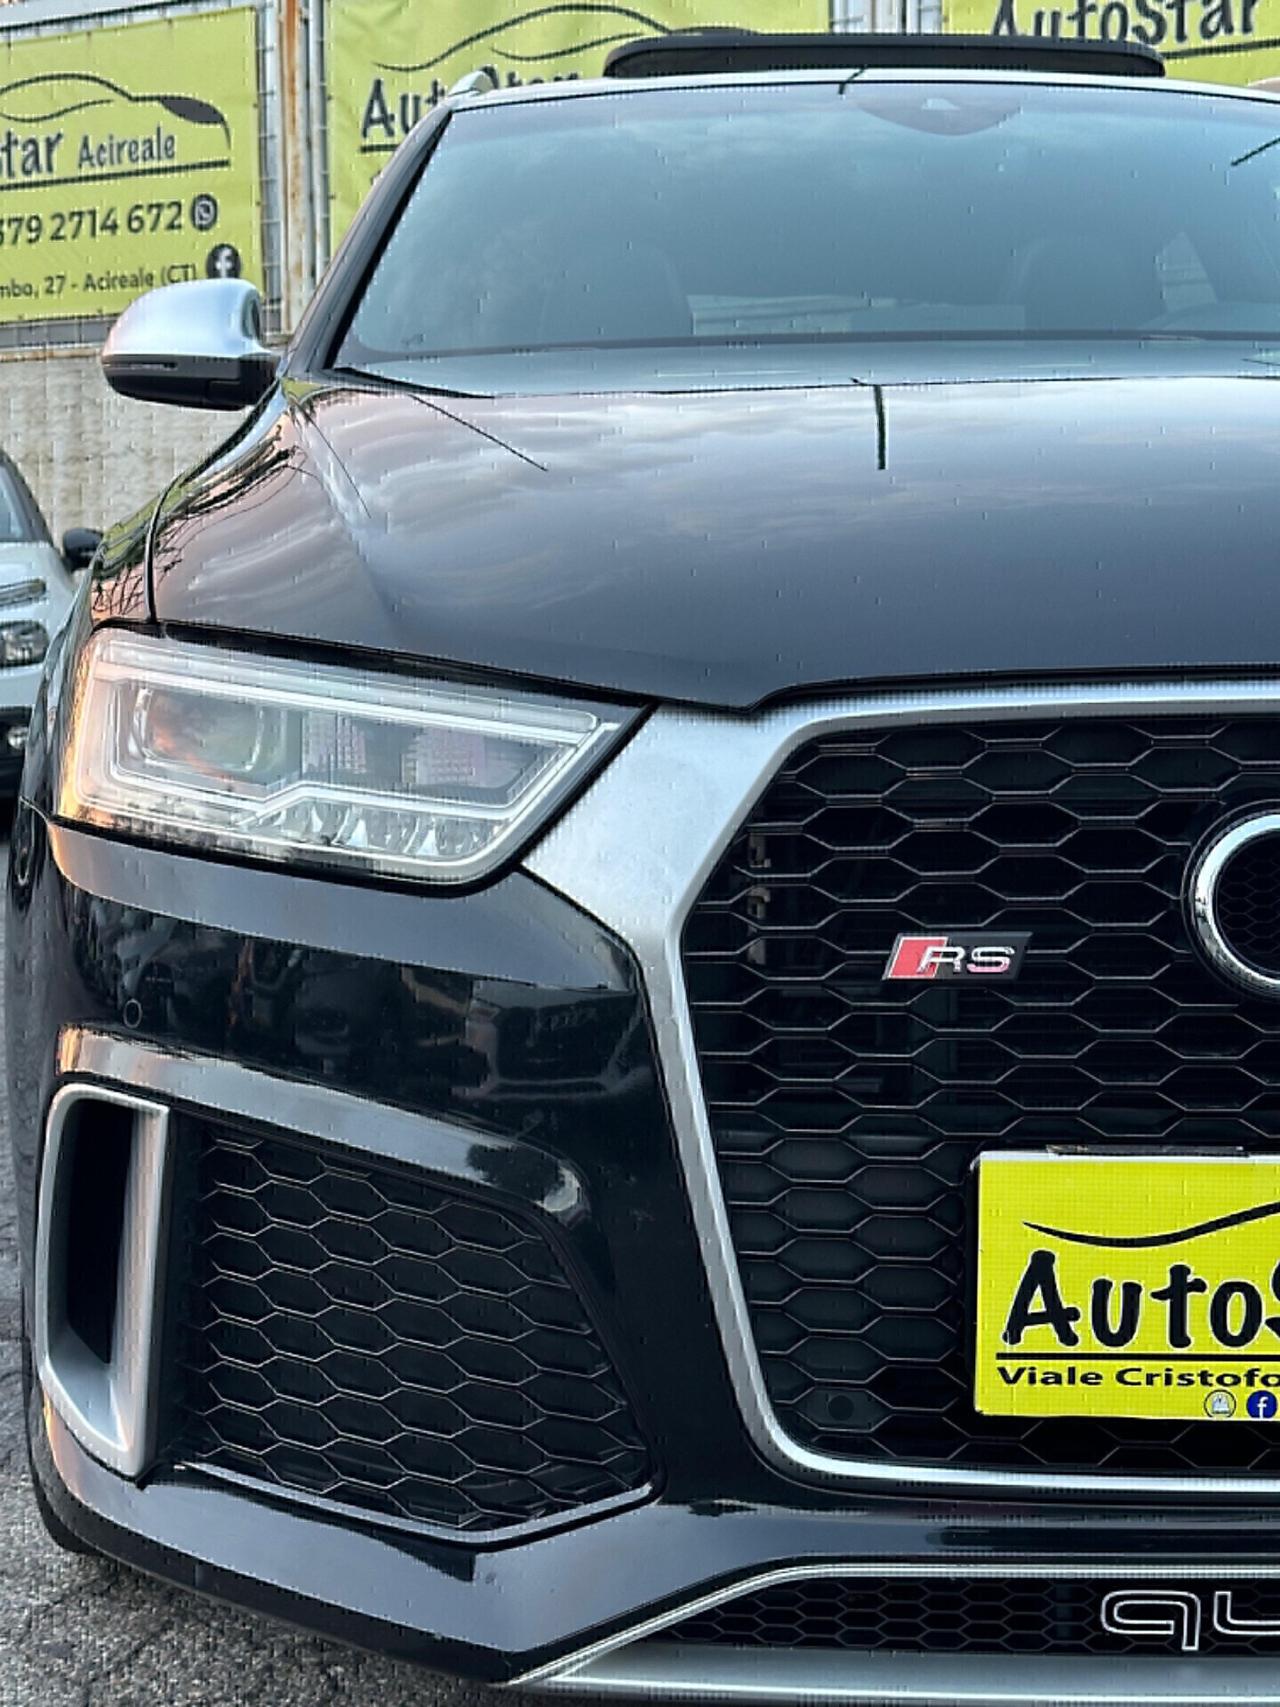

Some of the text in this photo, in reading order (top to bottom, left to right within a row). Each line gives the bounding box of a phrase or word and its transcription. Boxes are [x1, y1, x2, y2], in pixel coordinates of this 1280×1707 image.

[0, 126, 176, 178] tar Acireale
[50, 208, 119, 241] 2714
[127, 200, 183, 234] 672
[44, 274, 66, 295] 27
[83, 267, 154, 293] Acireale
[916, 946, 1015, 974] RS
[997, 1366, 1280, 1388] Viale Cristofo
